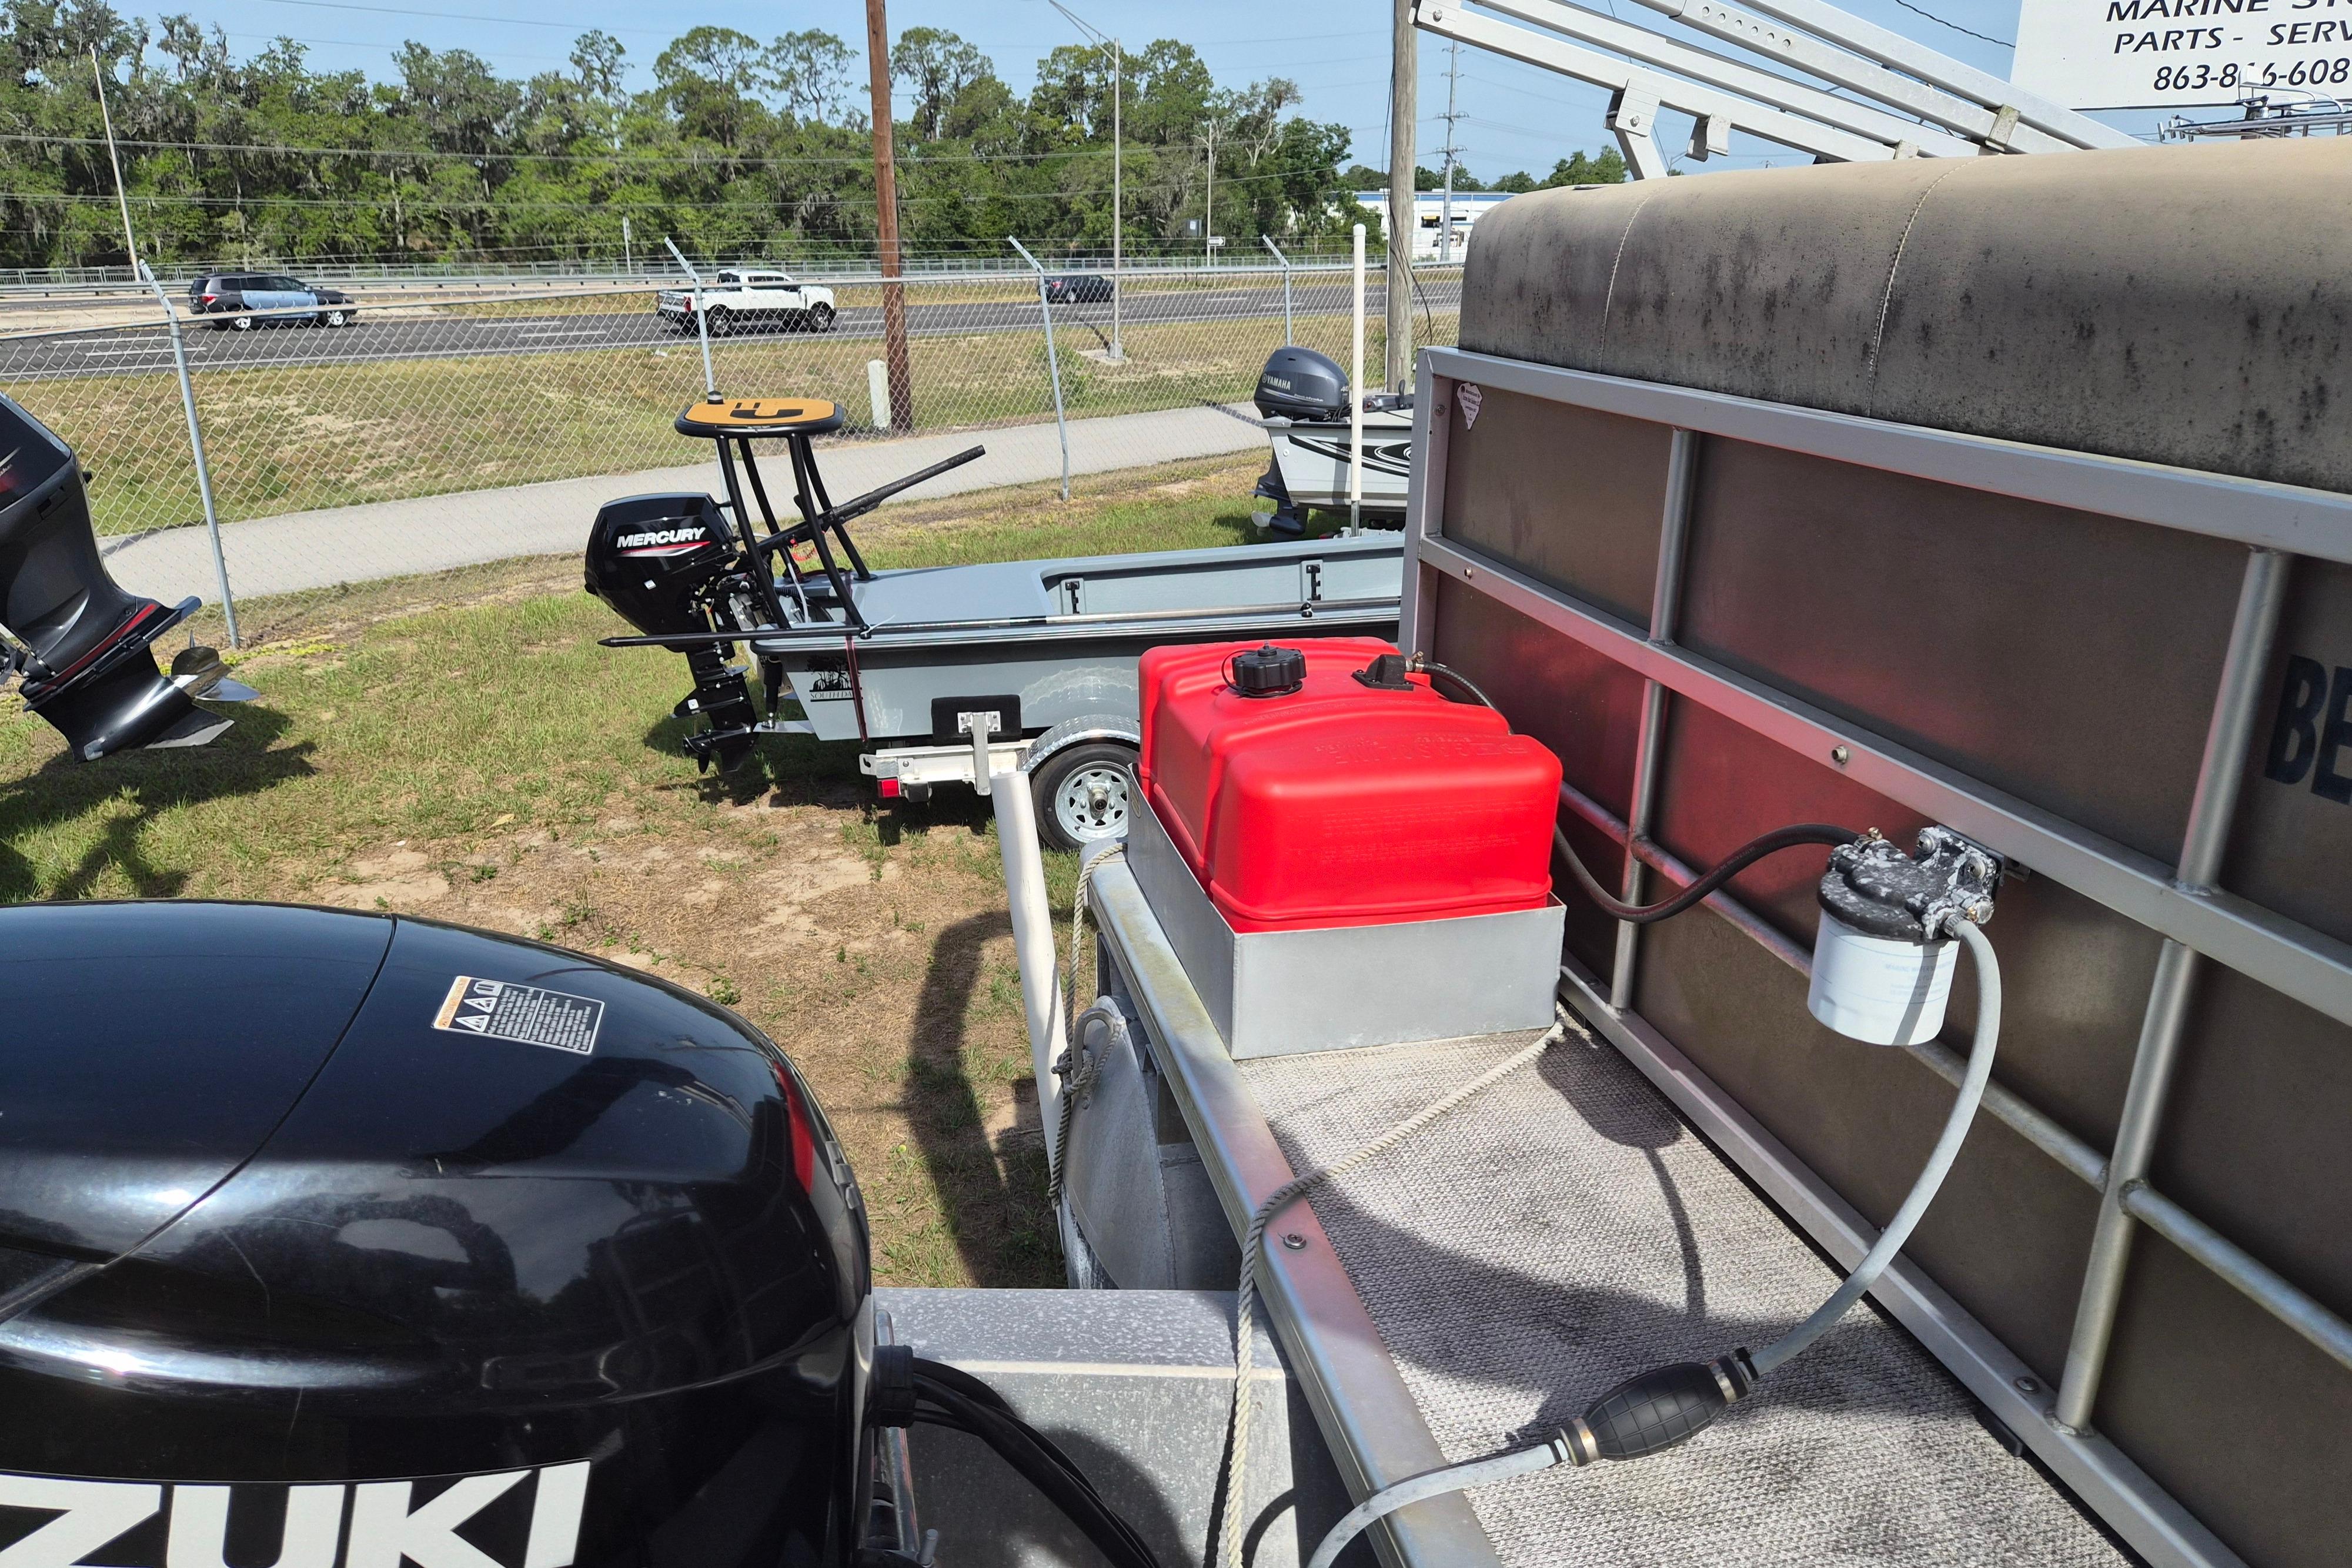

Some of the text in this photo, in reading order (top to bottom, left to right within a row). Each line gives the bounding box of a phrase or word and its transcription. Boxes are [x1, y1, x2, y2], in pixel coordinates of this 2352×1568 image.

[2106, 0, 2269, 22] MARINE
[2114, 27, 2224, 54] PARTS
[2153, 58, 2351, 91] 863-86-608
[1267, 375, 1291, 391] YAMAHA
[616, 527, 706, 549] MERCURY
[0, 1459, 590, 1568] ZUKI
